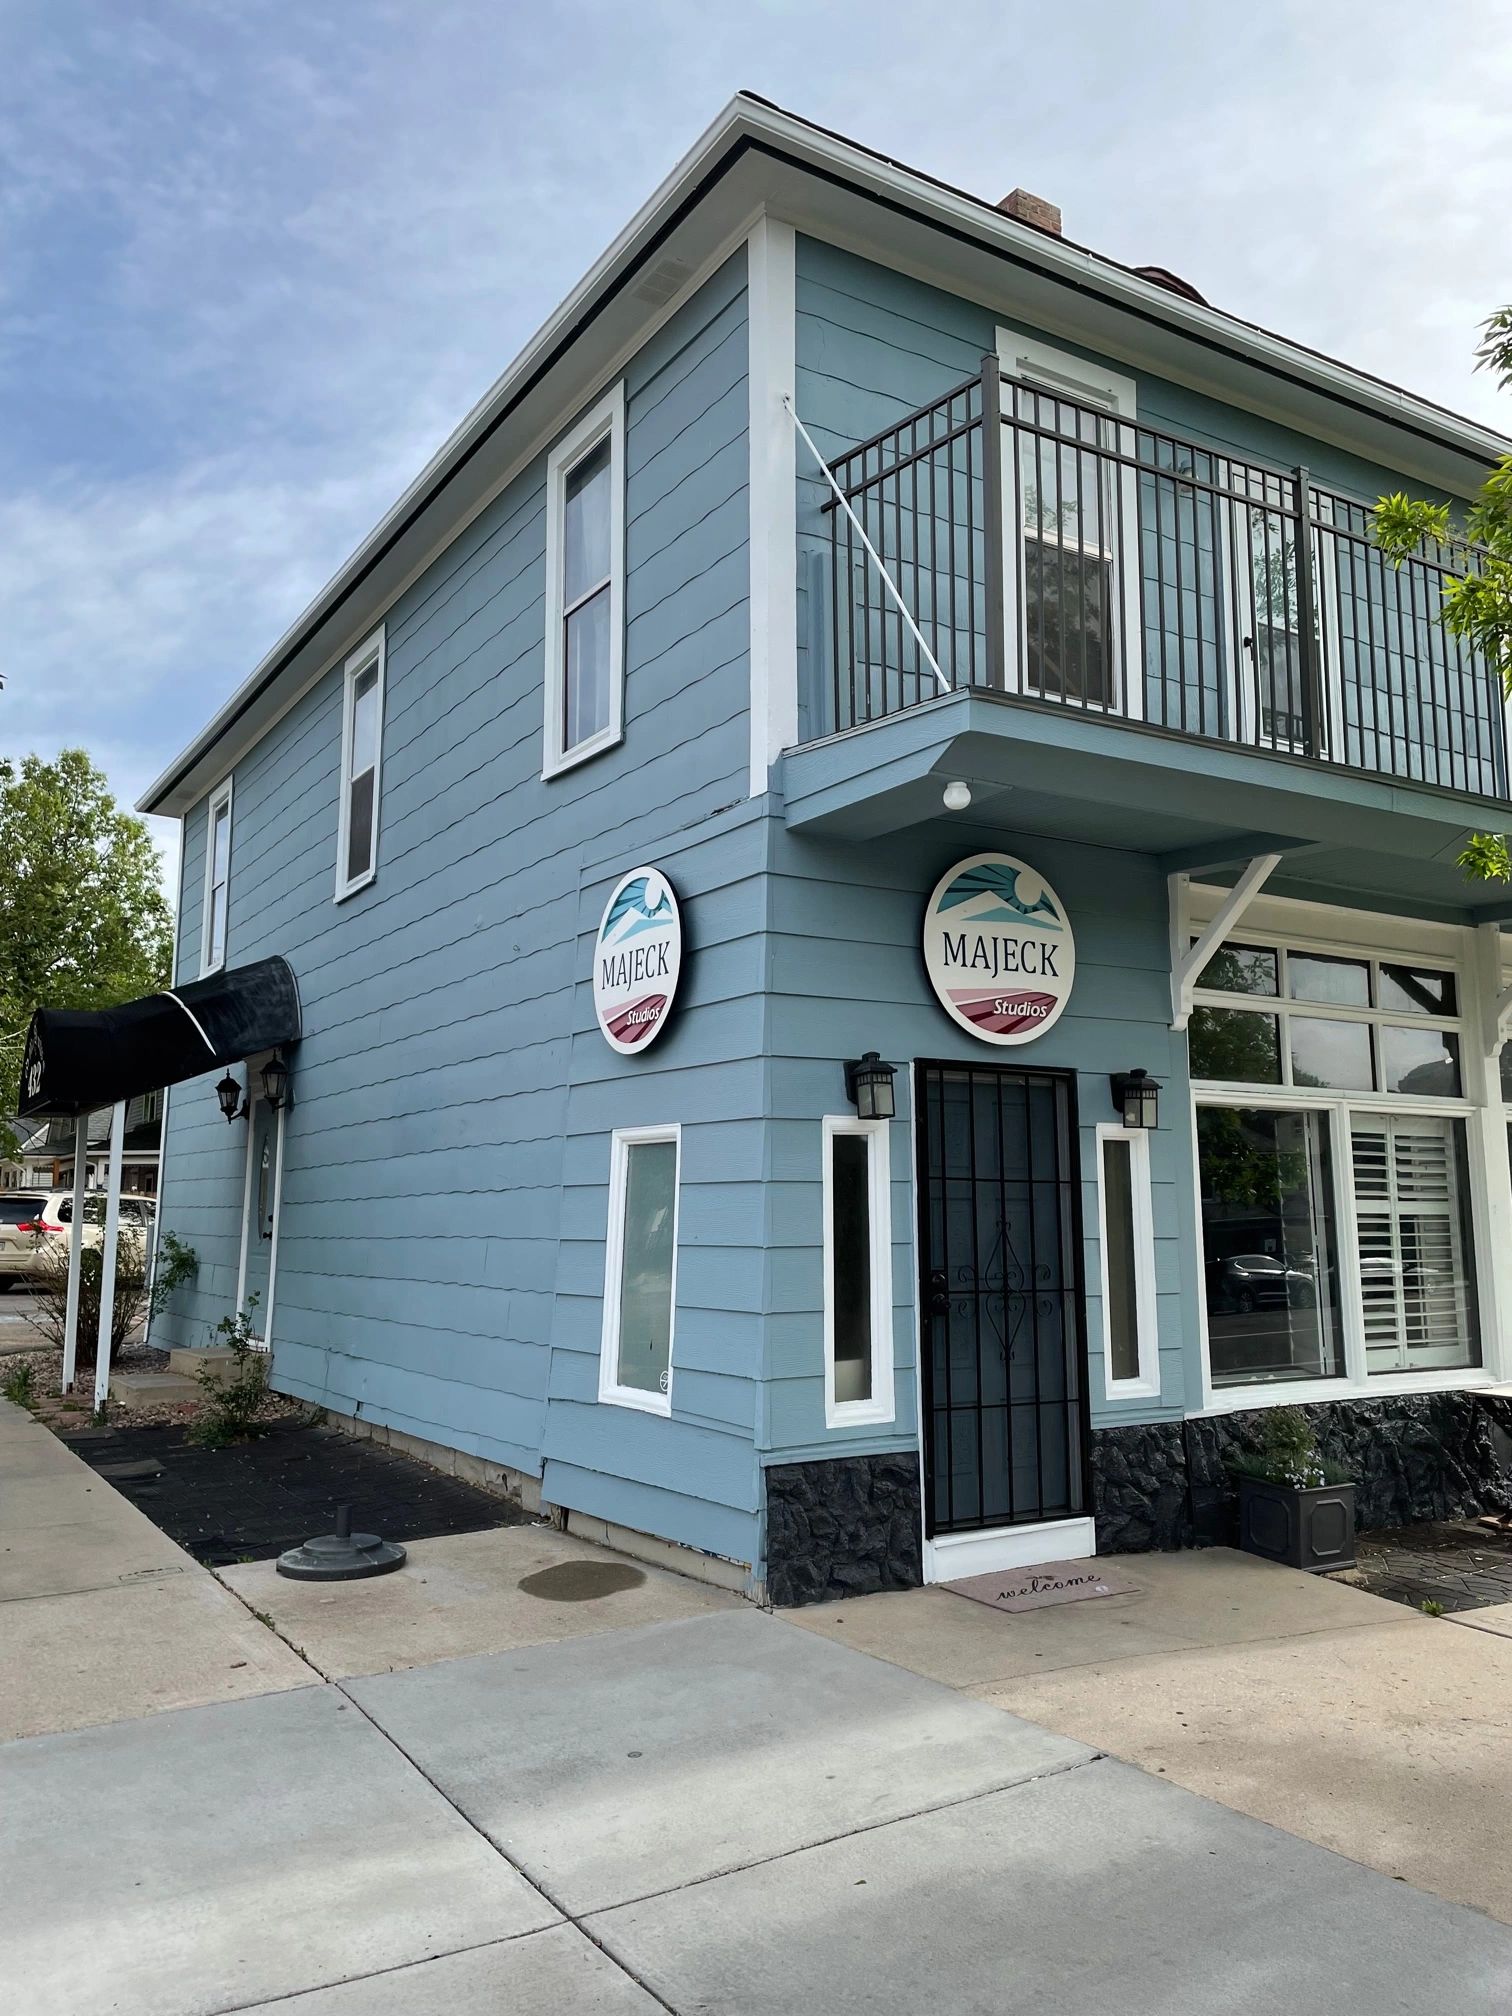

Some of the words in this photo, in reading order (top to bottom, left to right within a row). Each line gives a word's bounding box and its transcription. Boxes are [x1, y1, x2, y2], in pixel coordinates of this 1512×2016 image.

[601, 940, 671, 992] MAJECK
[942, 931, 1059, 978] MAJECK
[626, 1006, 661, 1026] Studios
[993, 1000, 1048, 1018] Studios
[28, 1061, 42, 1098] 432
[996, 1574, 1101, 1601] welcome
